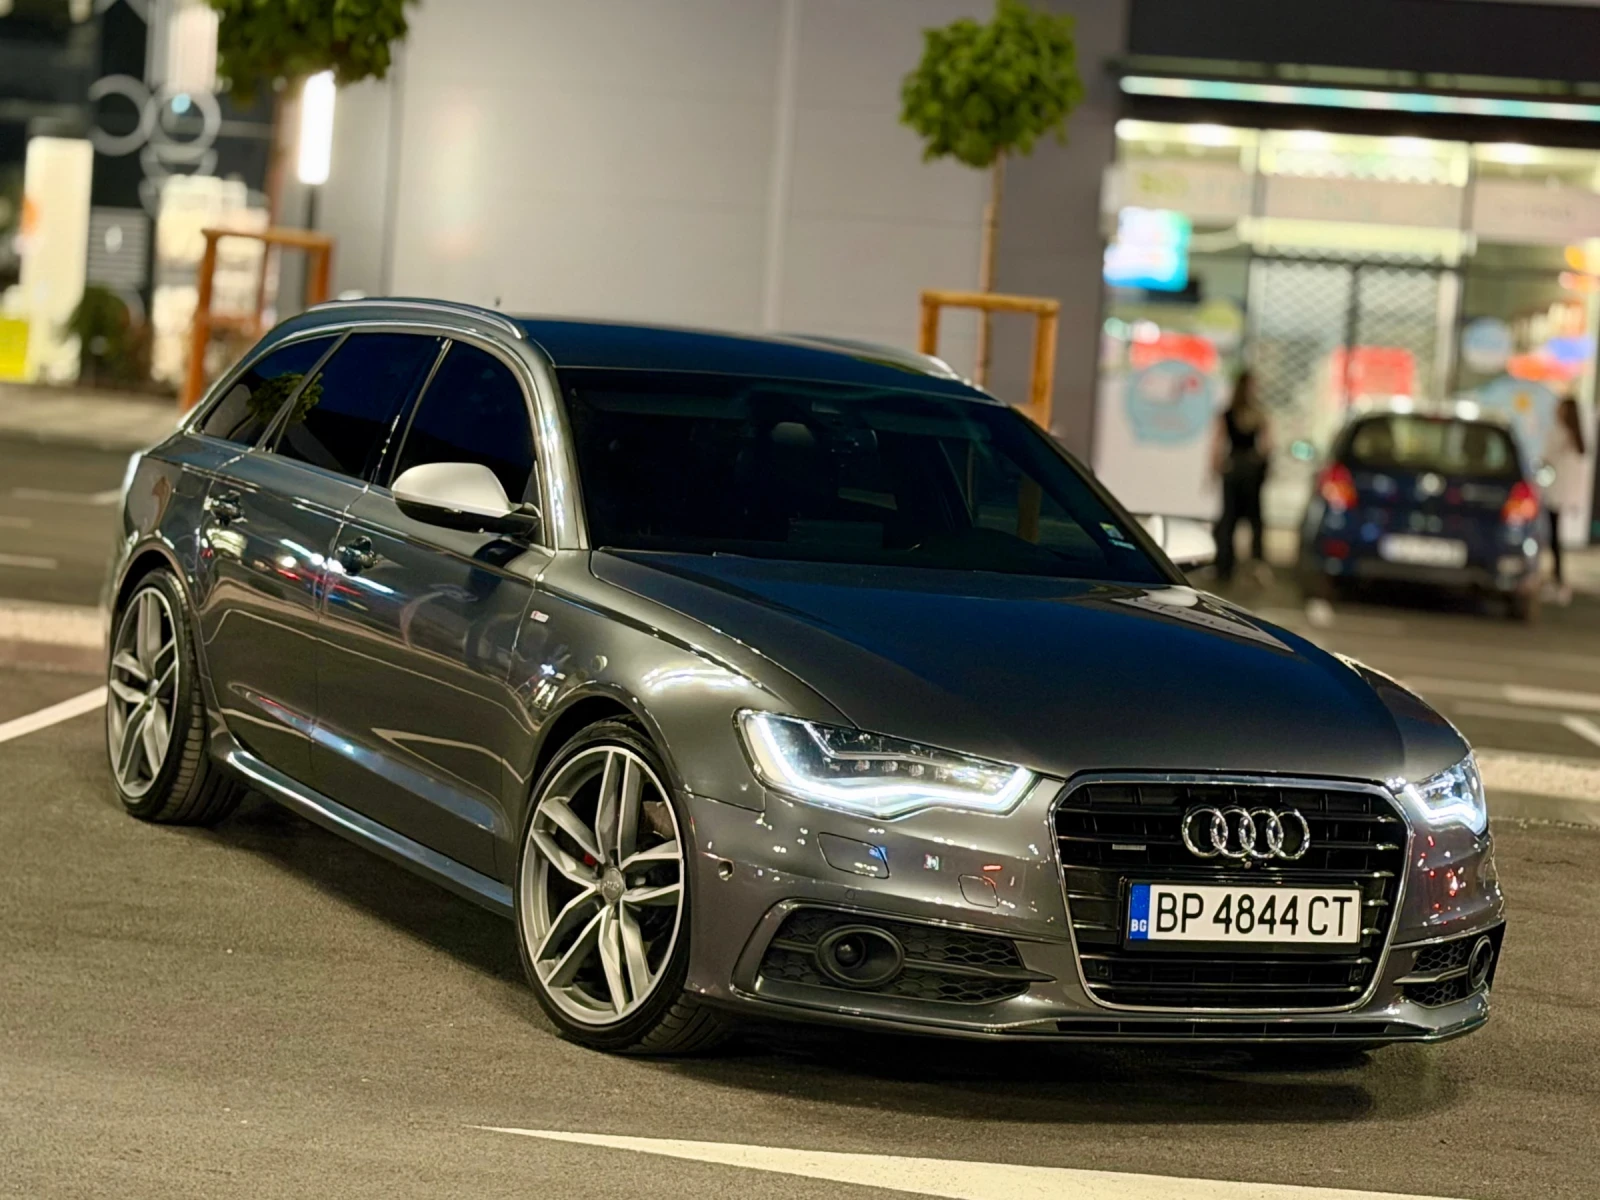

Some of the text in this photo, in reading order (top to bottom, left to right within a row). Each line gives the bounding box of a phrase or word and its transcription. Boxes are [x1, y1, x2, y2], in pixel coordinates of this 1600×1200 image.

[1131, 918, 1147, 932] BG
[1155, 892, 1353, 936] BP 4844 CT
